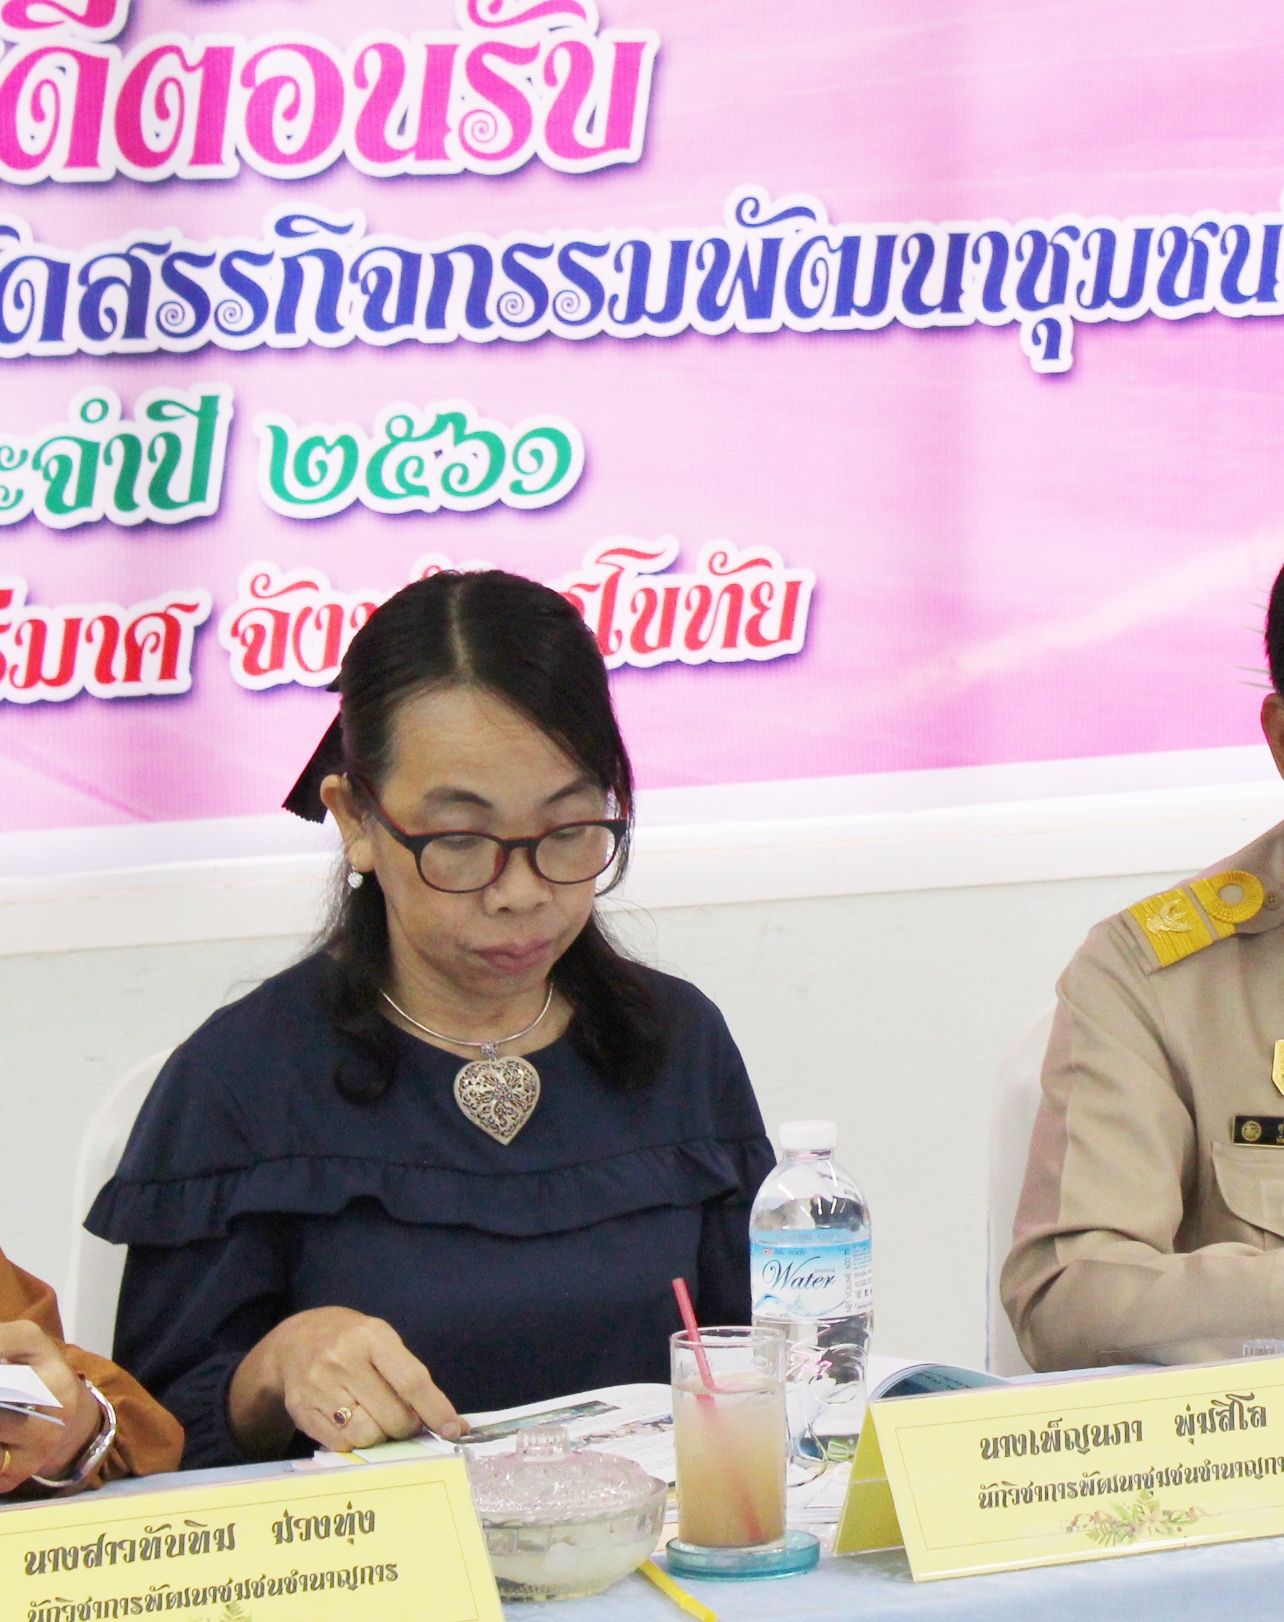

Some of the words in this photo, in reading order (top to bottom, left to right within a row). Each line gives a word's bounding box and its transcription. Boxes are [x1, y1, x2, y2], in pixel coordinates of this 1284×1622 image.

[265, 411, 573, 505] ๒๕๖๑
[0, 588, 200, 690] มาศ
[762, 1255, 836, 1290] Water
[979, 1417, 1143, 1460] นางเพ็ญนภา
[24, 1519, 236, 1576] นางสาวทับทิม
